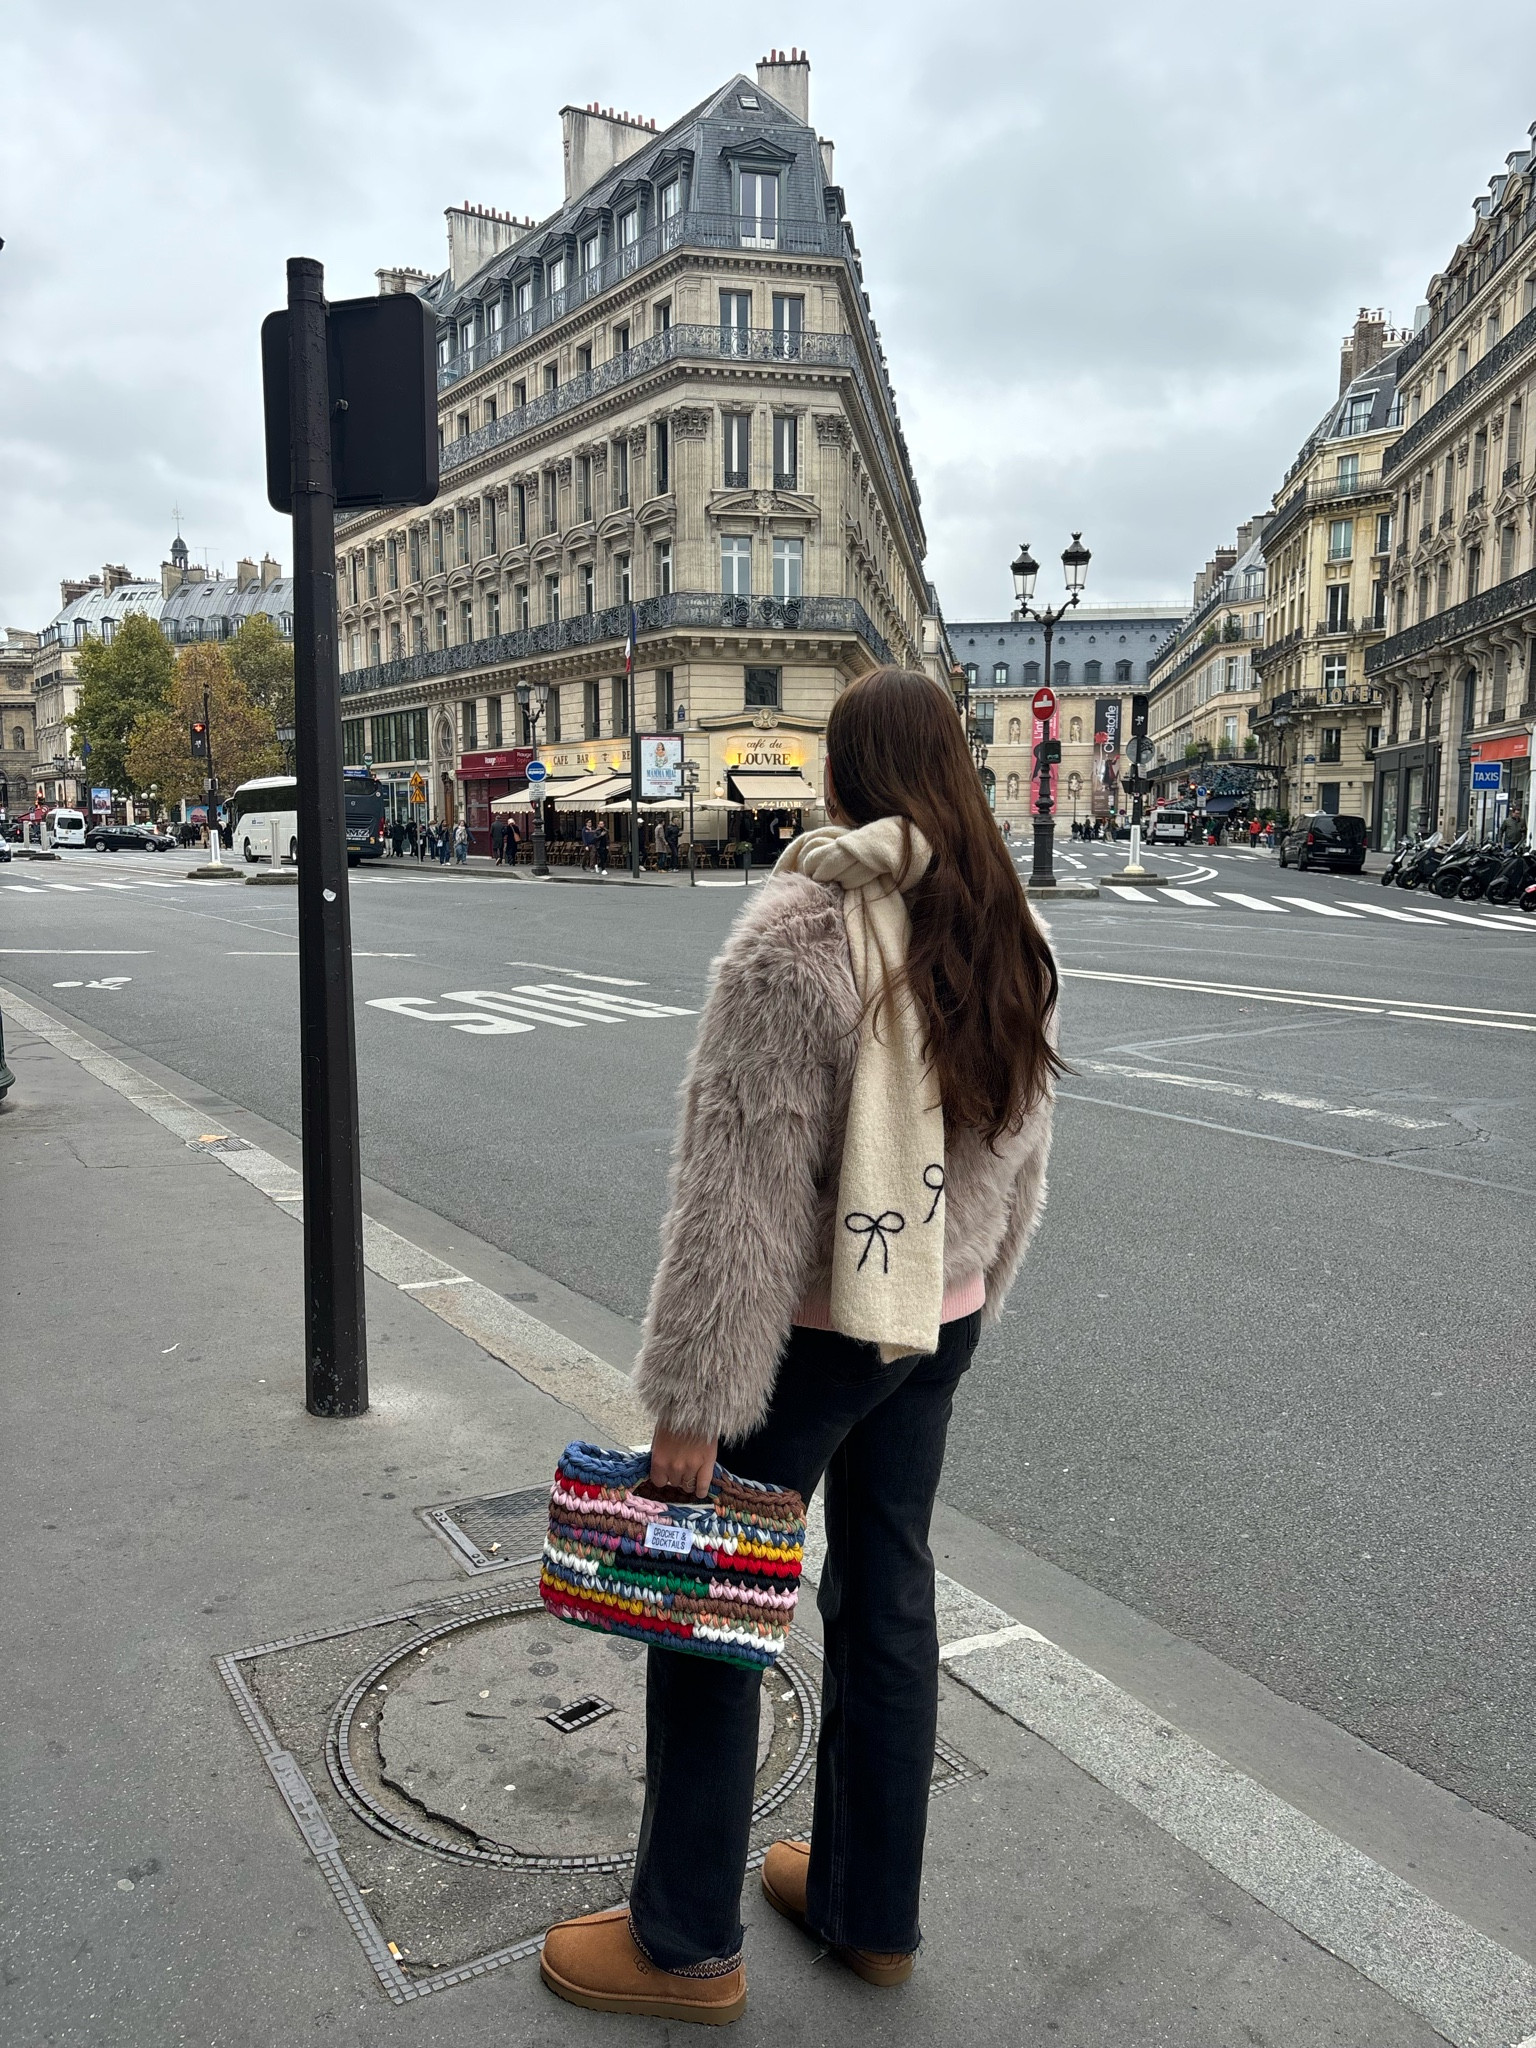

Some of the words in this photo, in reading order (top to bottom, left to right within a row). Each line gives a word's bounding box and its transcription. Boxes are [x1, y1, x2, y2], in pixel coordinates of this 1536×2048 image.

[1316, 686, 1382, 705] HOTEL
[1103, 705, 1116, 753] Christofle
[746, 739, 766, 752] café
[769, 739, 783, 749] du
[516, 751, 532, 759] Rouge
[576, 754, 589, 764] BAR
[737, 752, 791, 766] LOUVRE
[1474, 771, 1499, 782] TAXIS
[654, 1528, 679, 1539] CROCHET
[680, 1532, 687, 1541] &
[651, 1536, 686, 1550] COCKTAILS
